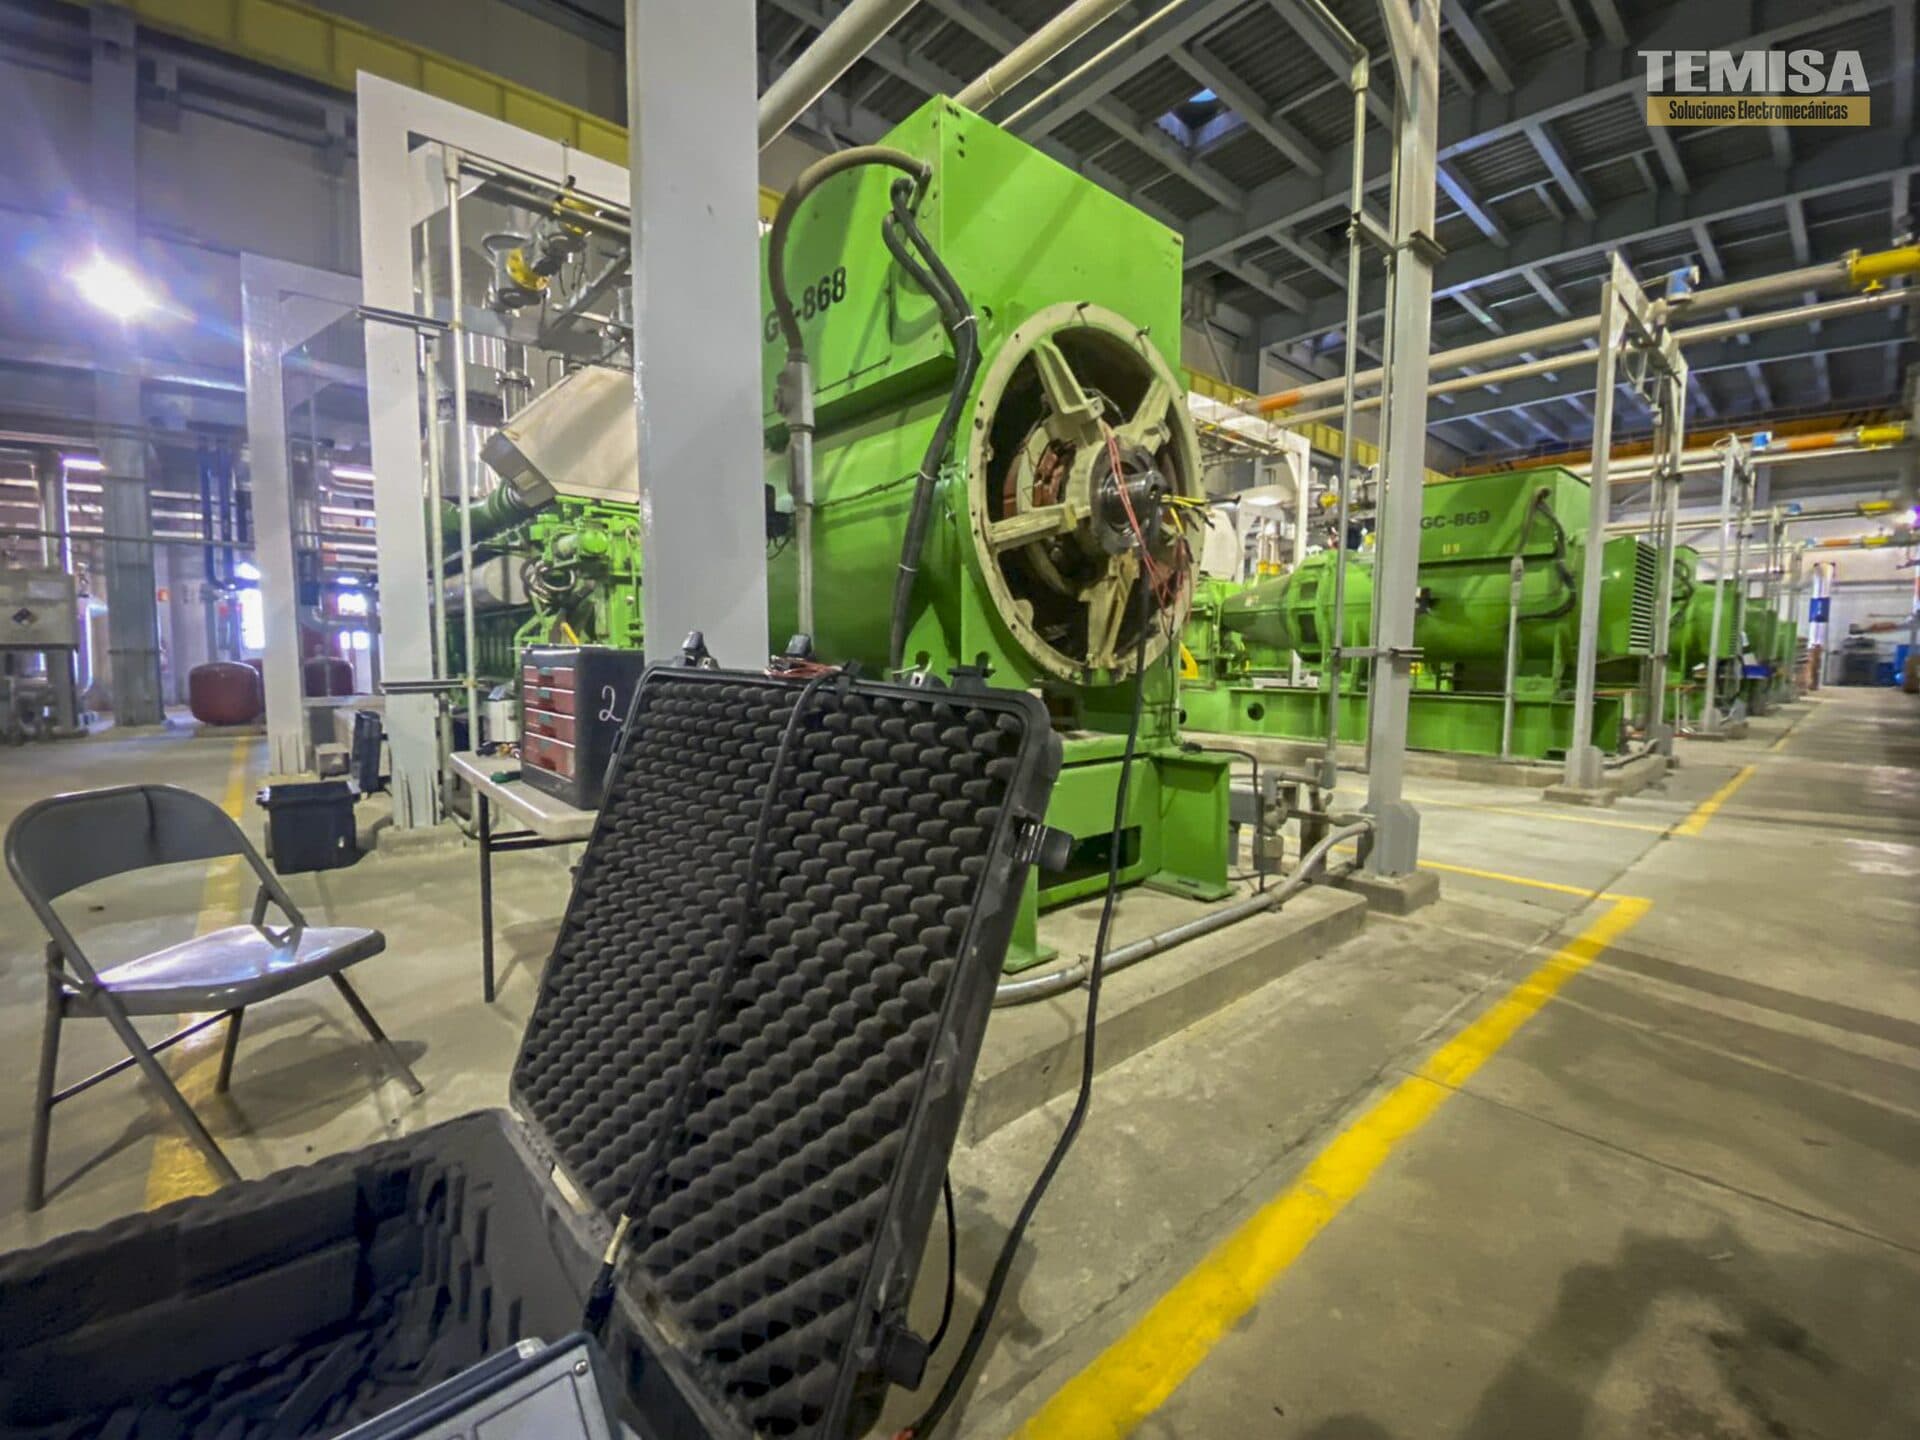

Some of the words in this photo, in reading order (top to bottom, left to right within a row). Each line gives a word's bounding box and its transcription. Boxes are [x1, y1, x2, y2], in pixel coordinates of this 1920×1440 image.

[764, 266, 846, 343] G-868
[1420, 510, 1490, 529] GC-869
[598, 685, 623, 721] 2
